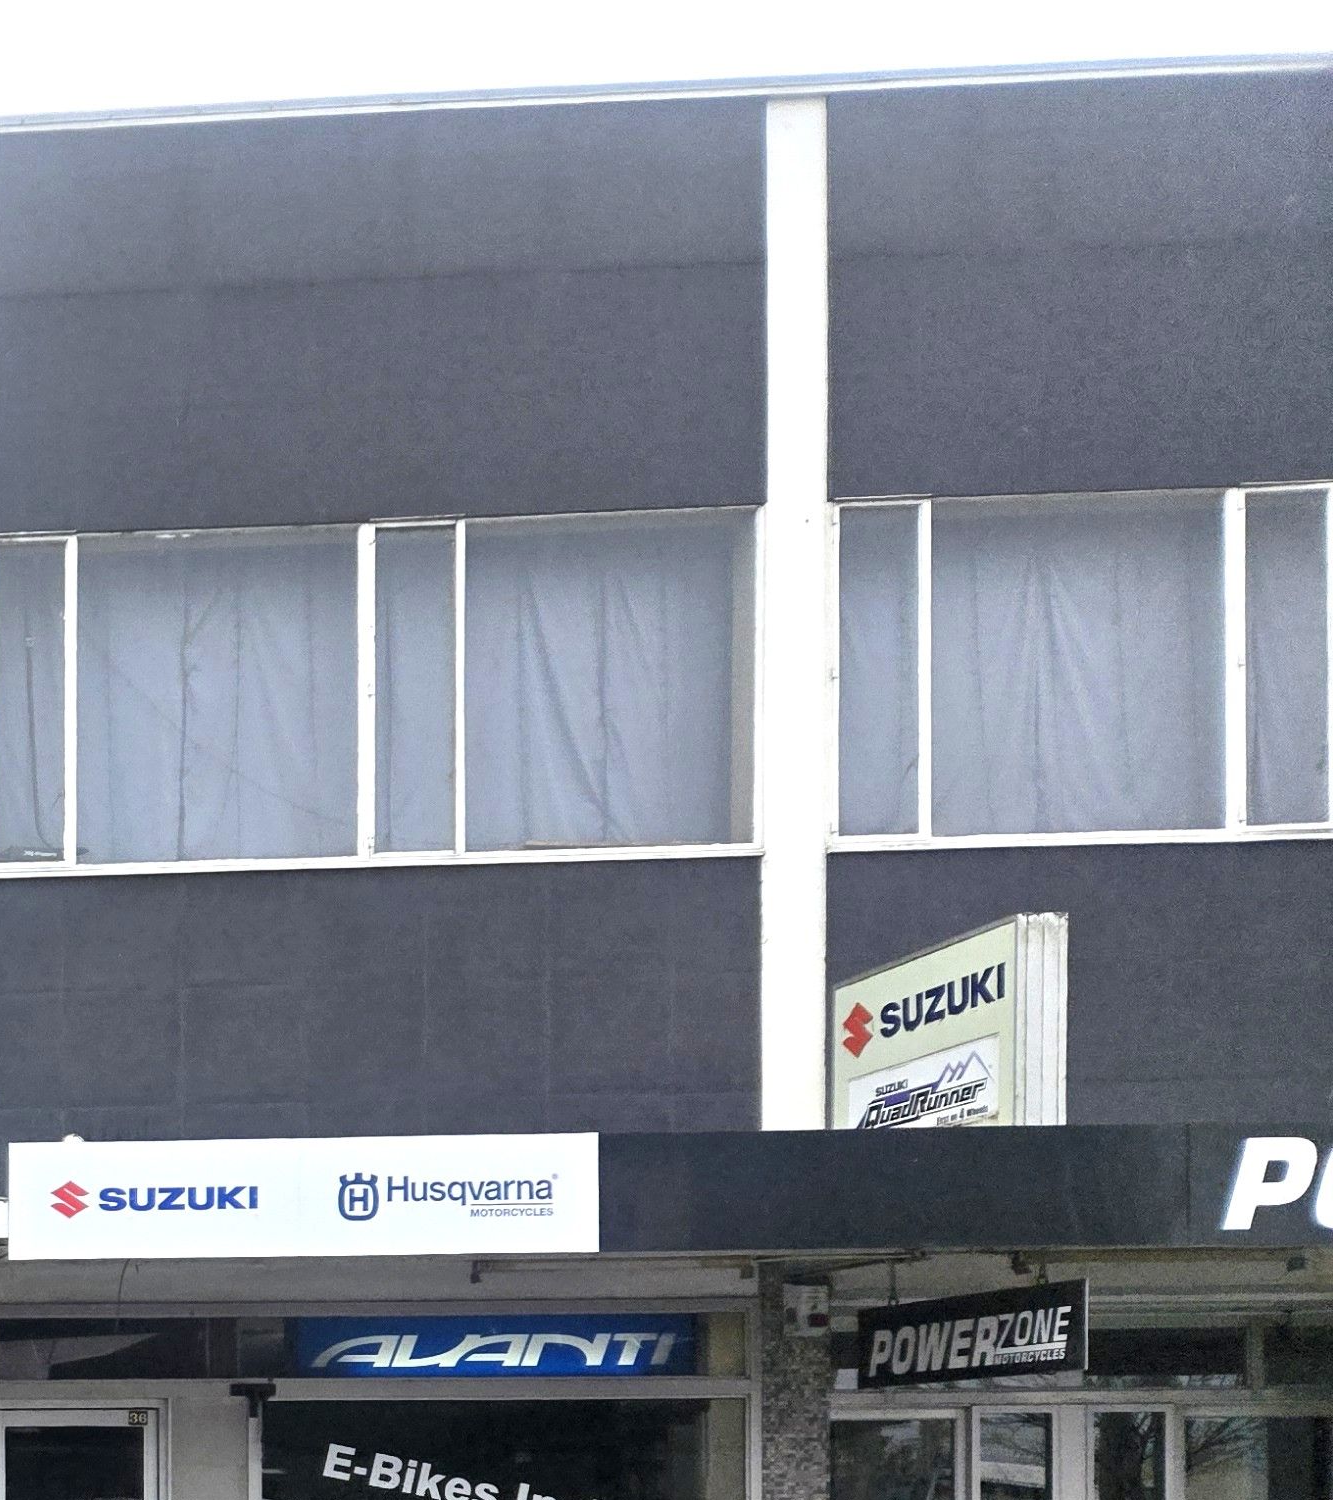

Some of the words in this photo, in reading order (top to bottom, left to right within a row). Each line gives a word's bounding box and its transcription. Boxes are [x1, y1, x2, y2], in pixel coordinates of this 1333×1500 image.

[880, 962, 1006, 1038] SUZUKI
[875, 1079, 908, 1097] SUZUKI
[387, 1175, 553, 1206] Husqvarna
[1219, 1136, 1333, 1231] P
[98, 1185, 258, 1212] SUZUKI
[470, 1207, 554, 1218] MOTORCYCLES
[311, 1332, 677, 1368] AVANTI
[993, 1348, 1066, 1366] MOTORCYCLES
[129, 1412, 148, 1425] 36
